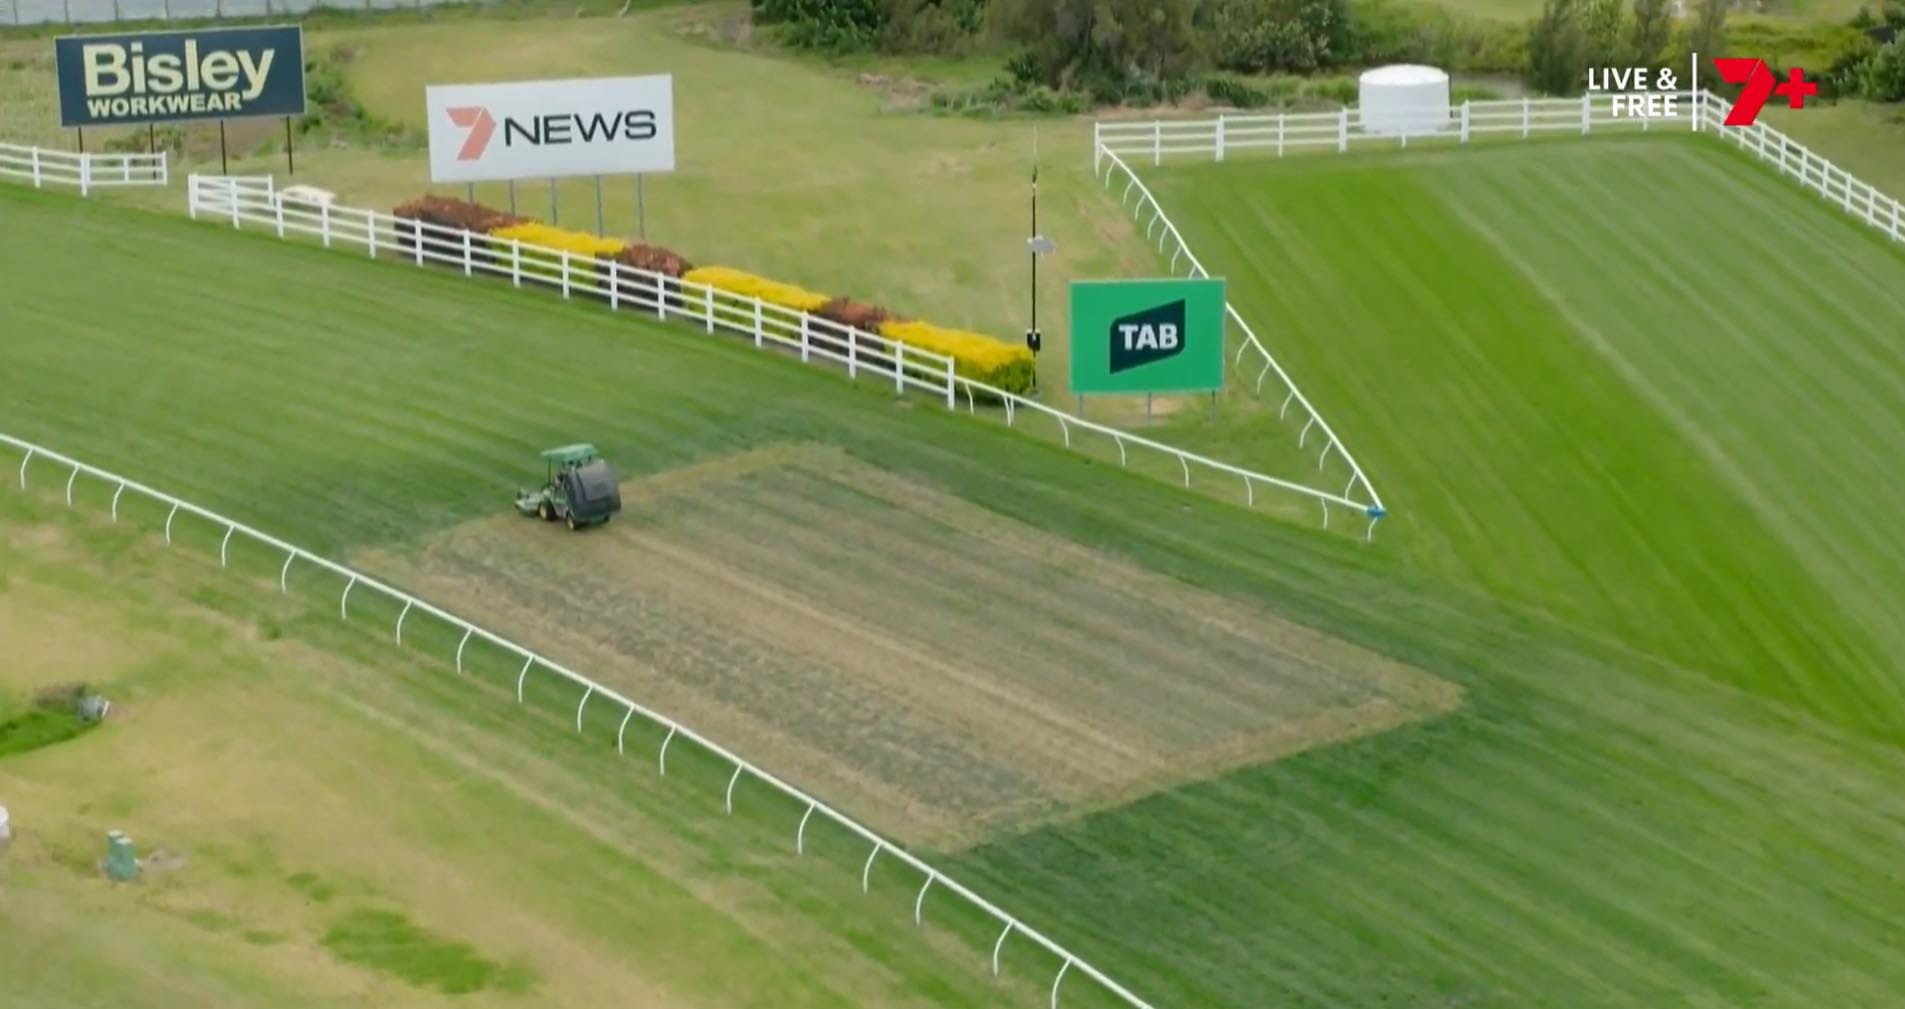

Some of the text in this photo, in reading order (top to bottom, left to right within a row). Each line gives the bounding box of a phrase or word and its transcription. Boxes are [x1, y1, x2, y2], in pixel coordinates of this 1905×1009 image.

[83, 39, 275, 100] Bisley
[88, 92, 242, 118] WORKWEAR
[504, 110, 657, 147] NEWS
[1118, 323, 1178, 350] TAB
